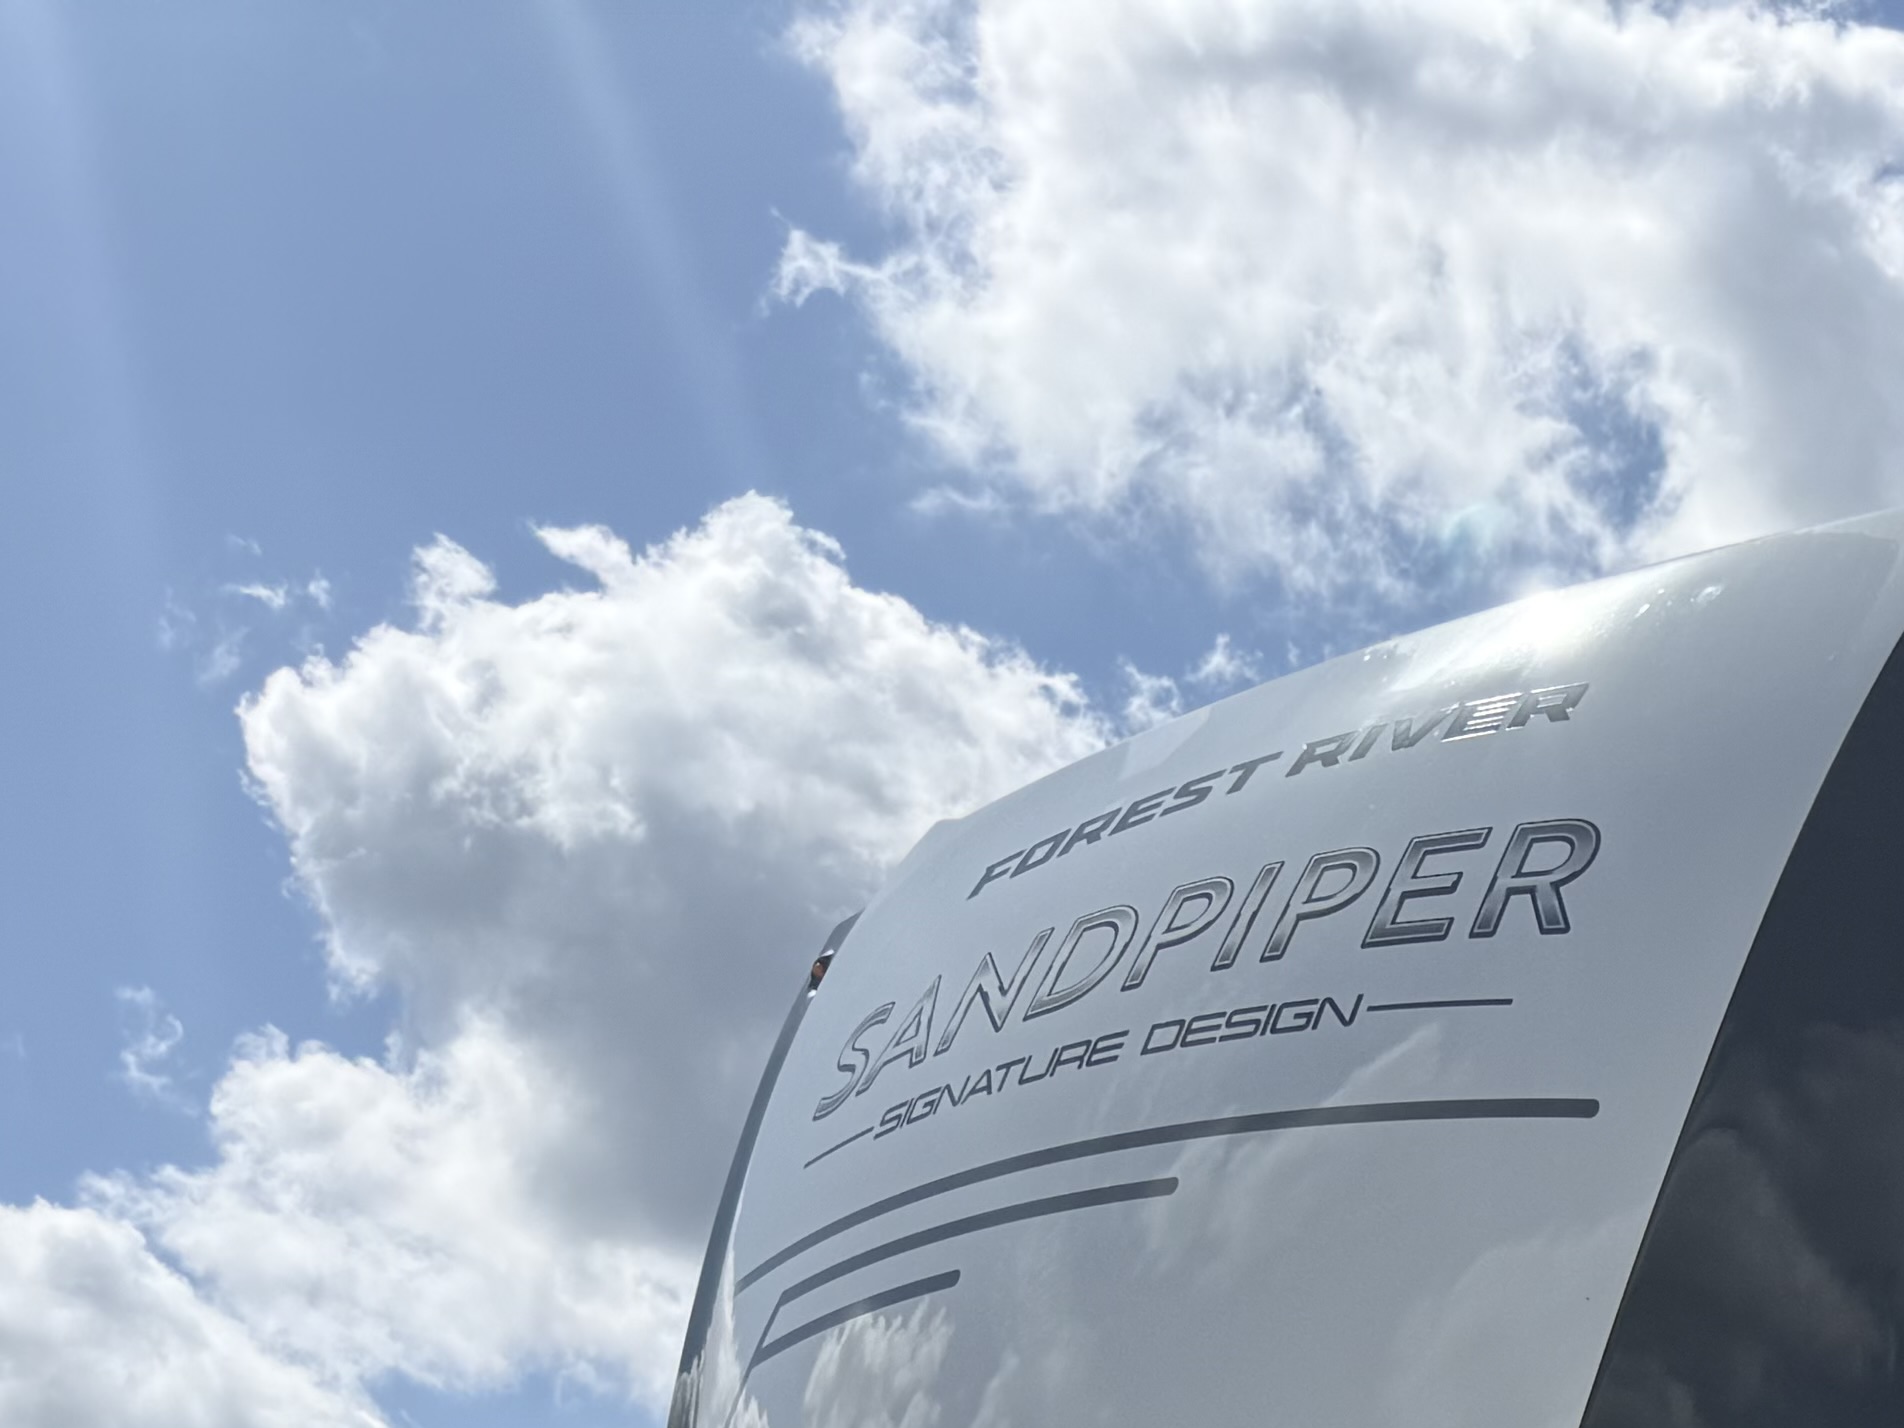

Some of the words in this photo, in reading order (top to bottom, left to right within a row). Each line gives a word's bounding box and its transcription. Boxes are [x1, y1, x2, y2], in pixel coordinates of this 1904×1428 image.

[966, 752, 1283, 900] FOREST
[1286, 683, 1590, 778] RIVER
[812, 817, 1602, 1122] SANDPIPER
[873, 1030, 1130, 1141] SIGNATURE
[1140, 994, 1364, 1057] DESIGN
